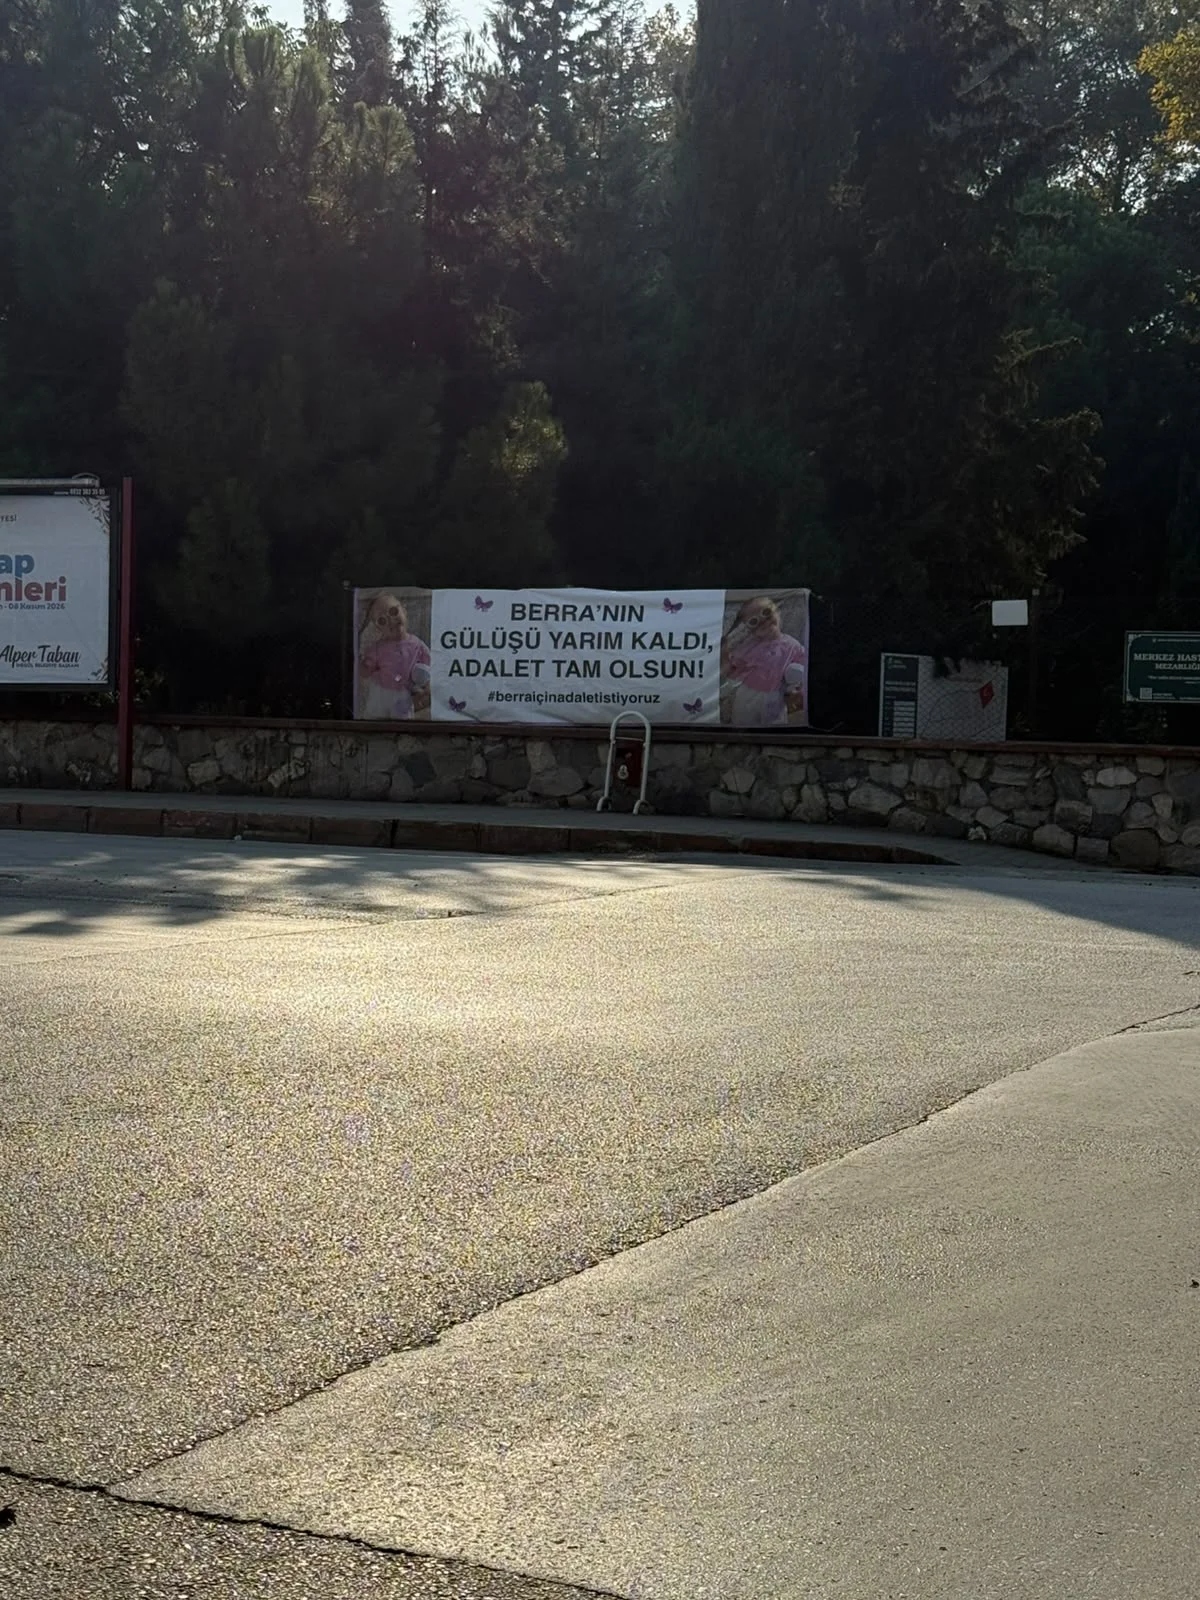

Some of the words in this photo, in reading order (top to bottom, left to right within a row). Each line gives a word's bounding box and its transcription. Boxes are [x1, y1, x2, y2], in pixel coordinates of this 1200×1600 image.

[440, 627, 542, 654] GÜLÜŞÜ
[549, 632, 623, 650] YARIM
[631, 632, 714, 653] KALDI,
[0, 645, 37, 668] Alper
[38, 645, 81, 663] Taban
[1134, 653, 1175, 661] MERKEZ
[448, 659, 545, 678] ADALET
[552, 660, 602, 678] TAM
[609, 660, 705, 679] OLSUN!
[487, 691, 661, 705] #berraiçinadaletistiyoruz
